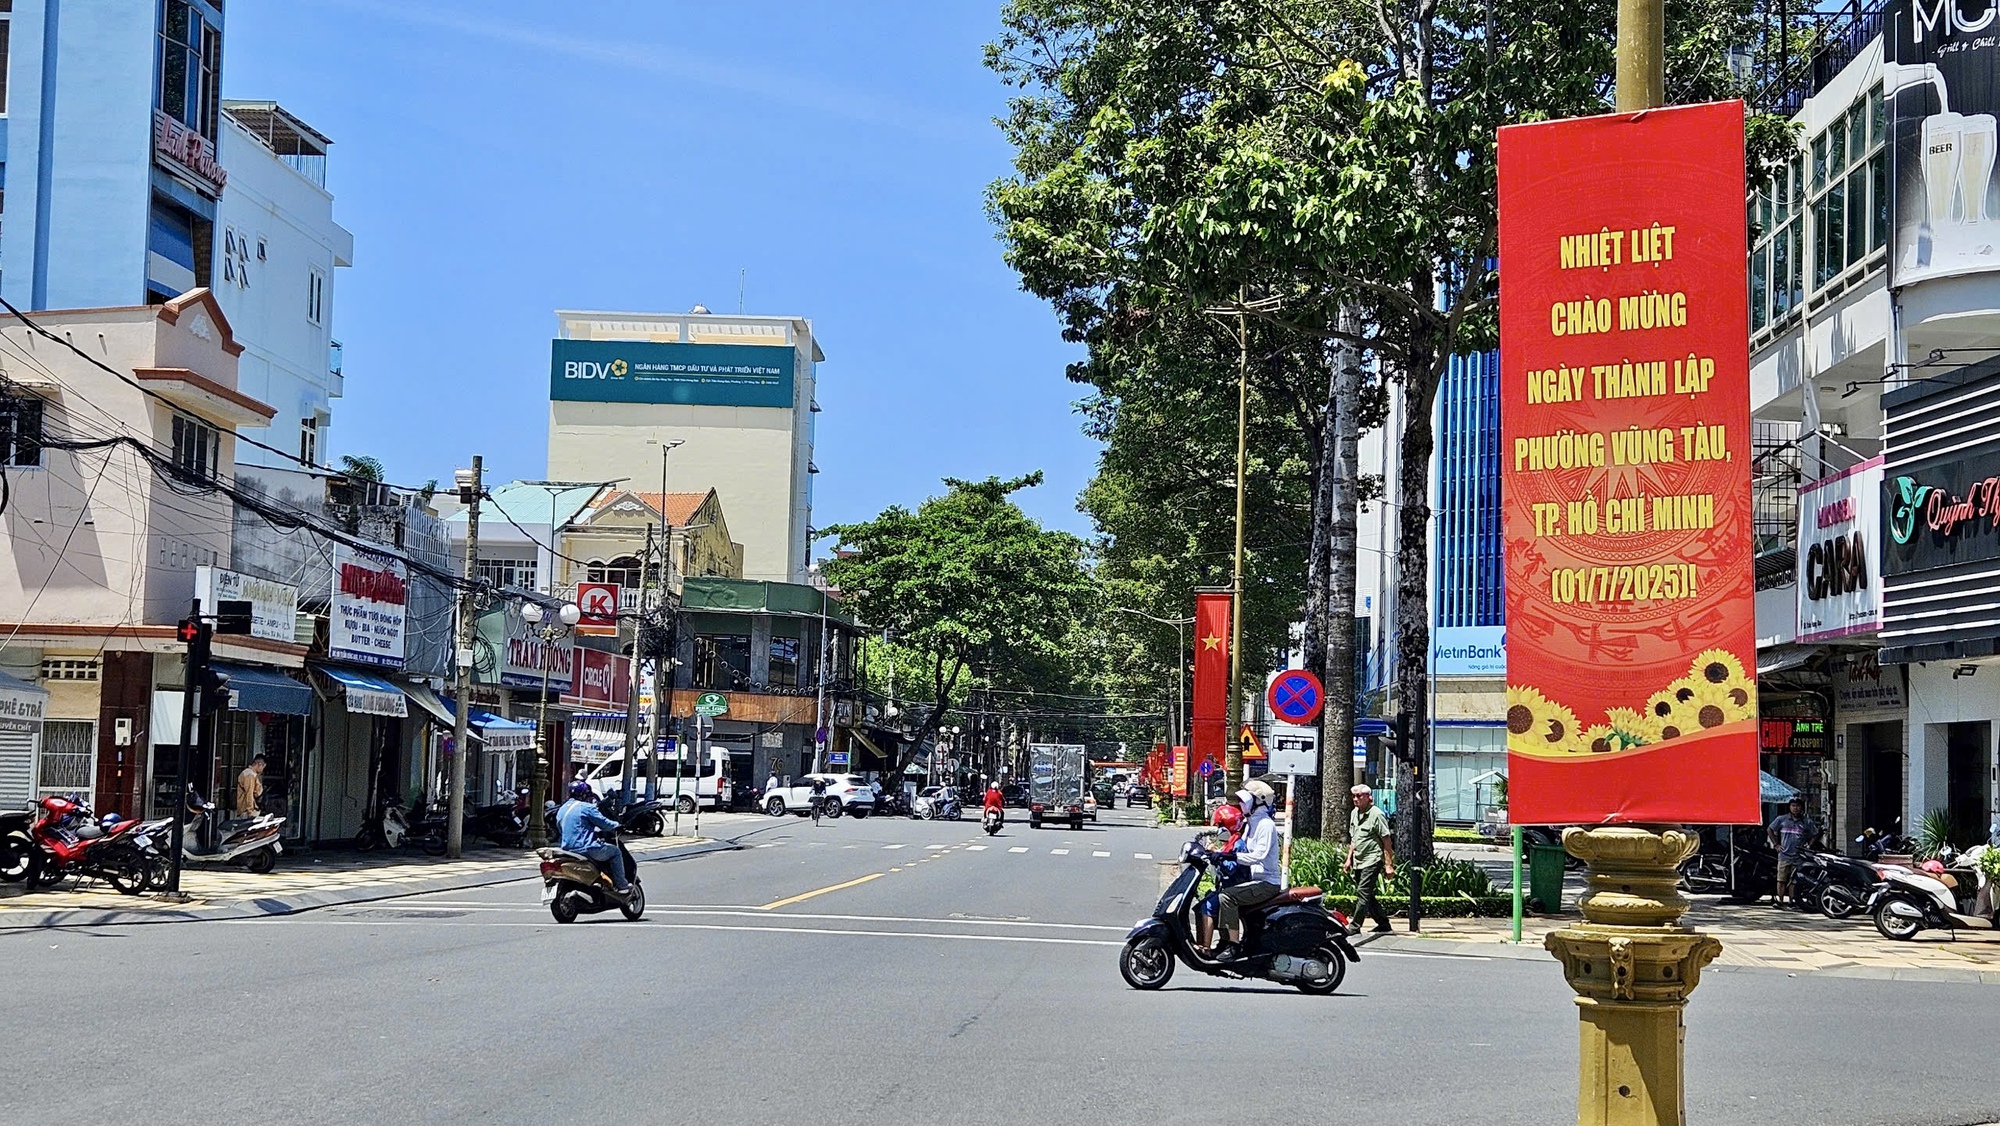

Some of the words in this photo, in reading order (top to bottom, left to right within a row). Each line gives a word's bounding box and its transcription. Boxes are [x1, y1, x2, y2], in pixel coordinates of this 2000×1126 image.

[1937, 41, 1960, 59] Grill
[1972, 36, 1996, 50] Chill
[1929, 143, 1953, 155] BEER
[1560, 226, 1624, 272] NHIỆT
[1631, 221, 1676, 267] LIỆT
[1551, 295, 1612, 336] CHÀO
[1619, 290, 1687, 331] MỪNG
[565, 361, 612, 380] BIDV
[652, 364, 669, 372] HÀNG
[670, 364, 687, 372] TMCP
[709, 365, 718, 373] VÀ
[718, 366, 733, 374] PHÁT
[752, 366, 766, 375] VIỆT
[1527, 363, 1585, 405] NGÀY
[1591, 359, 1667, 400] THÀNH
[1674, 353, 1715, 399] LẬP
[1515, 429, 1605, 471] PHƯỜNG
[1611, 425, 1674, 465] VŨNG
[1680, 421, 1732, 462] TÀU,
[1532, 502, 1561, 537] TP.
[1567, 489, 1599, 535] HỒ
[1605, 493, 1646, 534] CHÍ
[1652, 494, 1714, 529] MINH
[1927, 482, 1982, 536] Quỳnh
[1807, 530, 1868, 601] CARA
[1551, 564, 1698, 603] (01/7/2025)!
[590, 595, 609, 614] K
[362, 622, 371, 632] BIA
[351, 634, 371, 646] BUTTER
[374, 638, 392, 649] CHEESE
[1435, 645, 1502, 659] VietinBank
[585, 666, 602, 688] CIRCLE
[1762, 721, 1792, 752] CHỤP
